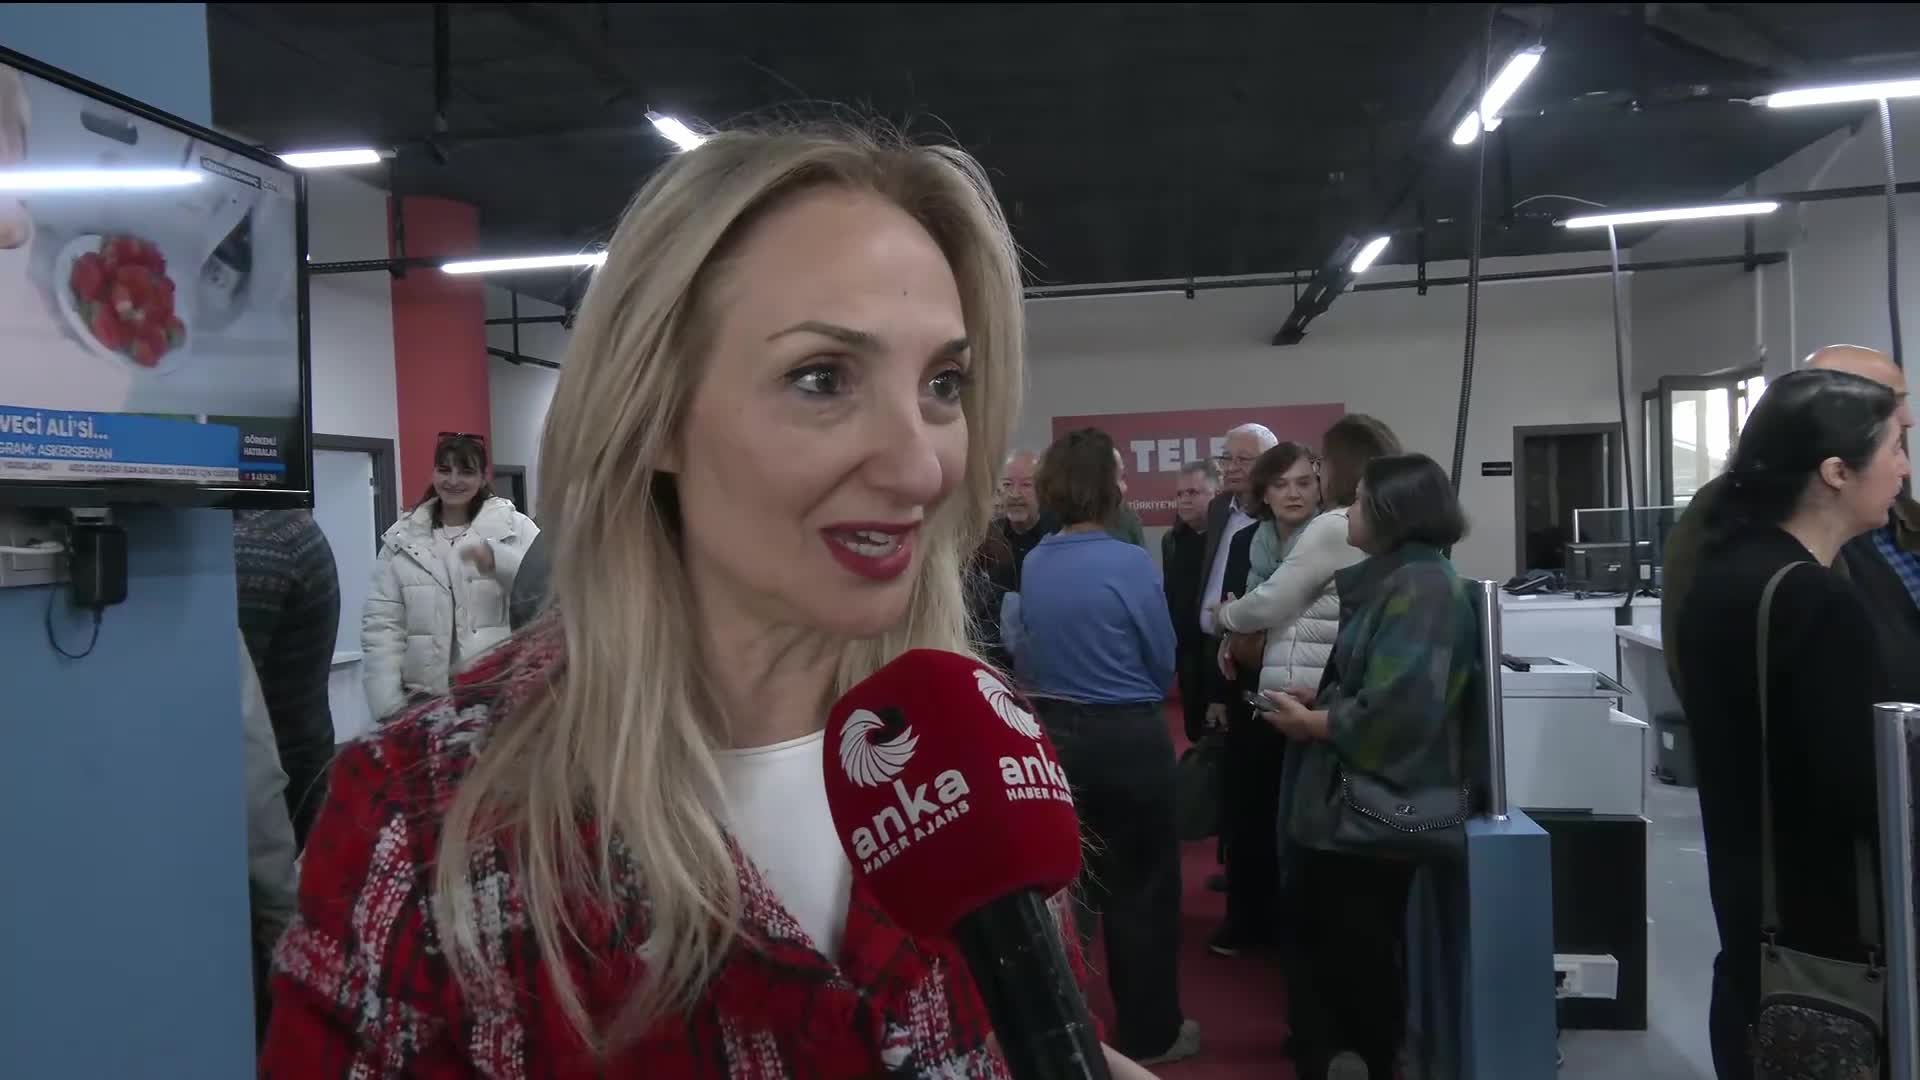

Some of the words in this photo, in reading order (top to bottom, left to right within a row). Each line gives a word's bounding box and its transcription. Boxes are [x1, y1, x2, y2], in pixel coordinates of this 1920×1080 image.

[852, 769, 970, 860] anka
[1006, 787, 1050, 801] HABER
[863, 835, 911, 875] HABER
[913, 800, 970, 842] AJANS
